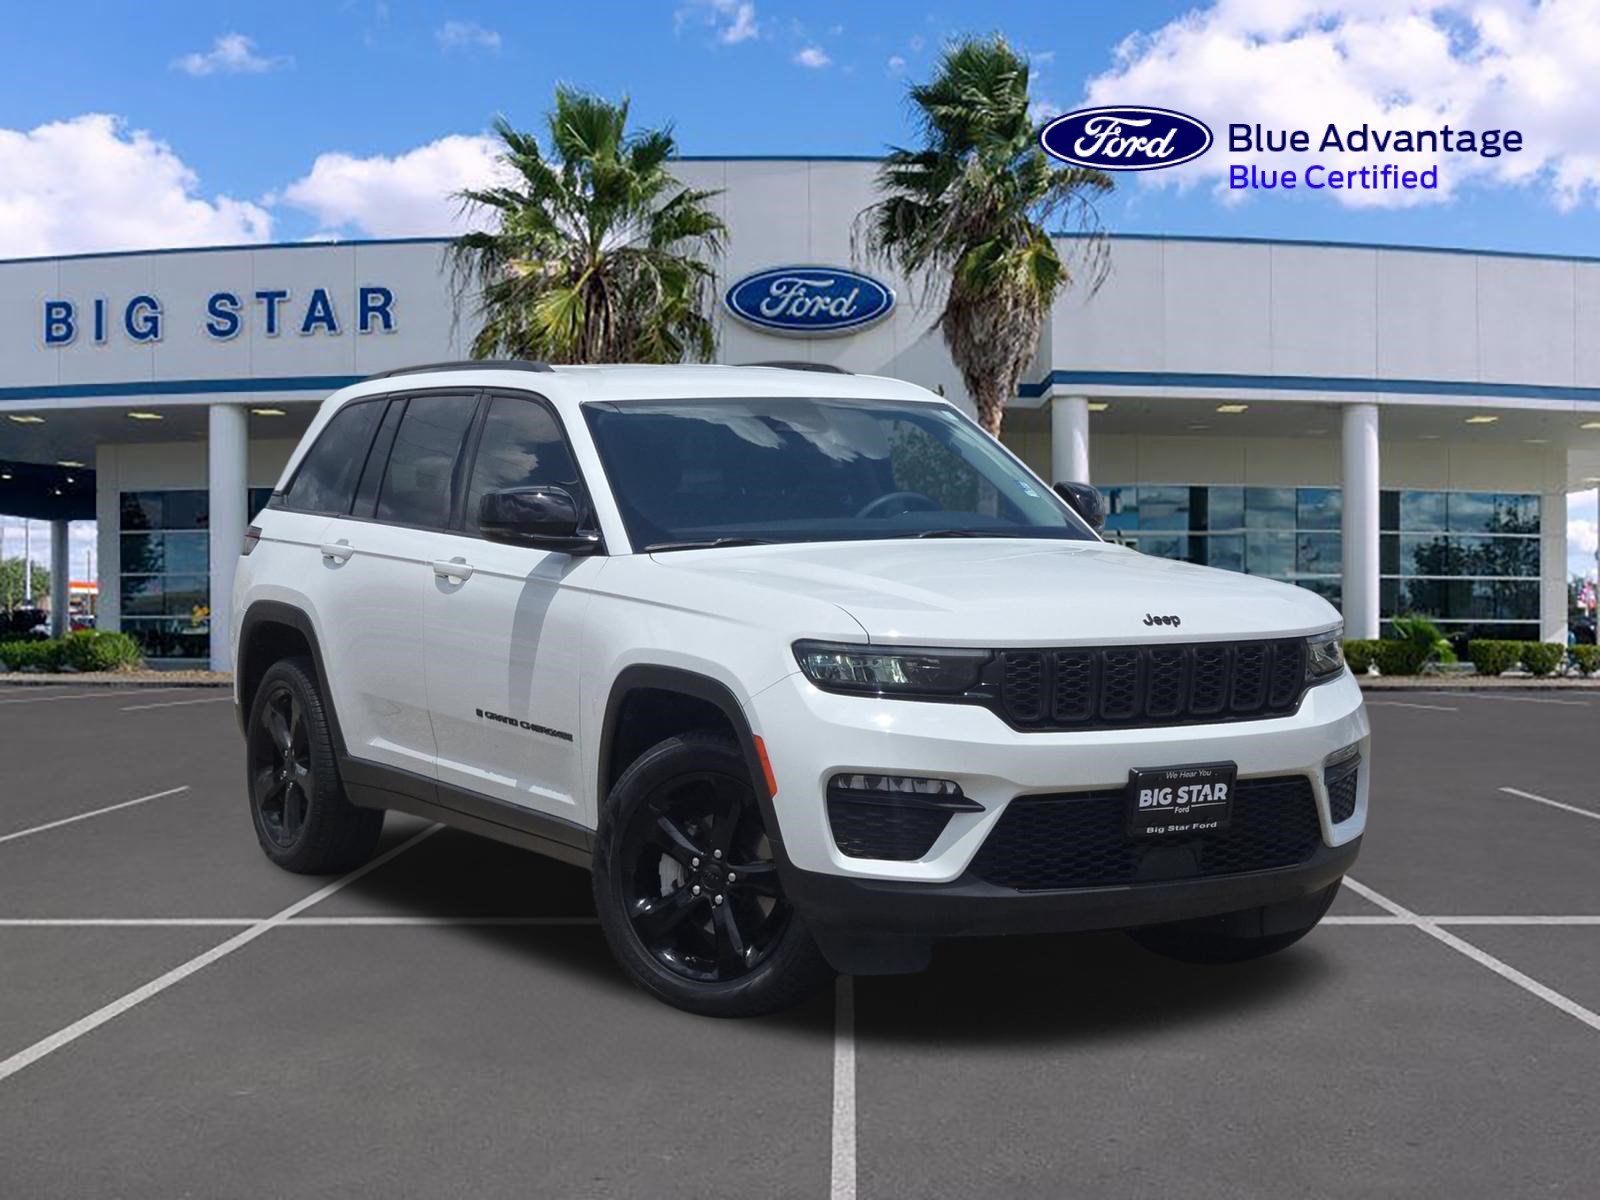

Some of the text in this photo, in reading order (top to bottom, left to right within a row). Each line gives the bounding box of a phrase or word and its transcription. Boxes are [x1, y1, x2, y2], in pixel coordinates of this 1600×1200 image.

[760, 277, 859, 317] Ford
[45, 287, 396, 344] BIG STAR
[1143, 613, 1181, 628] Jeep
[1166, 769, 1212, 779] We Hear You
[1139, 783, 1228, 807] BIG STAR
[1174, 805, 1190, 814] Ford
[1146, 821, 1217, 834] Big Star Ford
